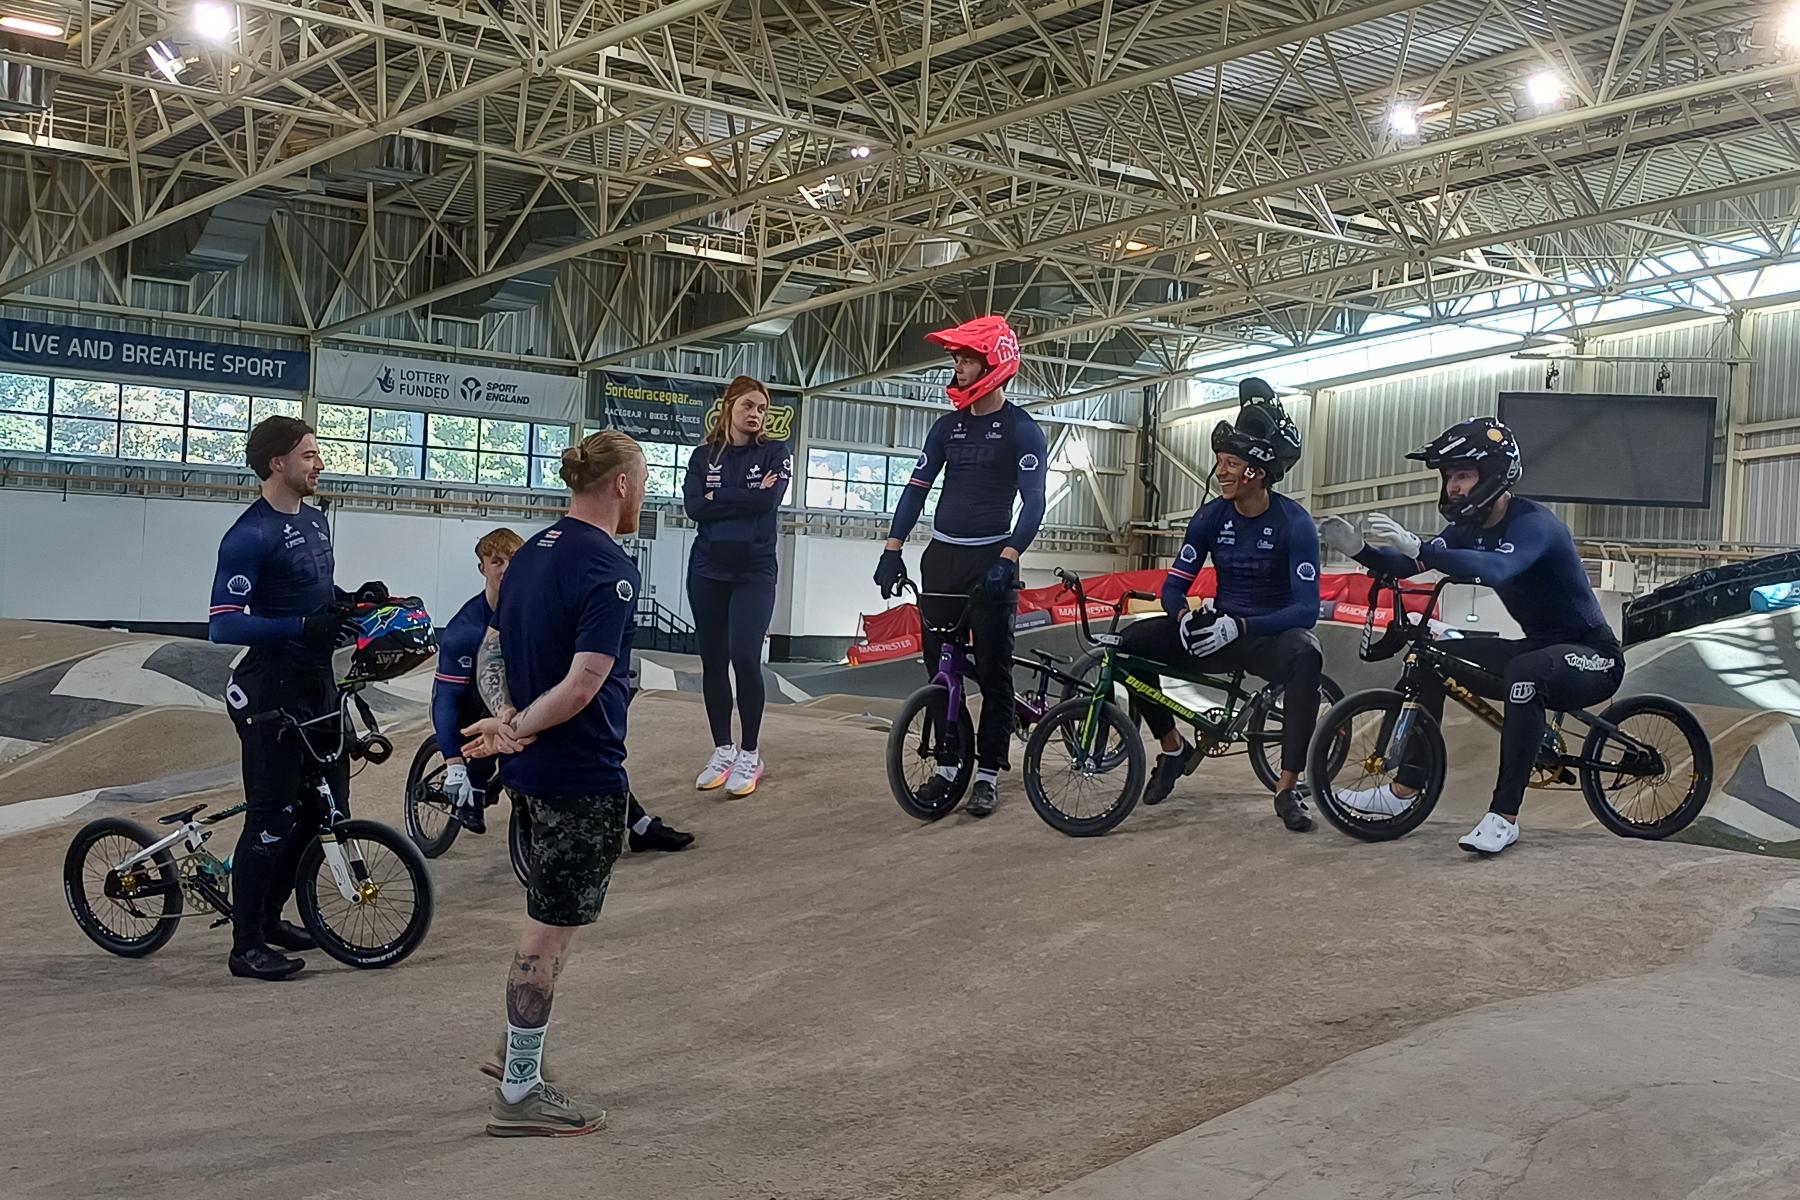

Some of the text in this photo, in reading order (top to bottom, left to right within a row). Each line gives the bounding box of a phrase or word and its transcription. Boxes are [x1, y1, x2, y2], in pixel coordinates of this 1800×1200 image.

[12, 331, 287, 378] LIVE AND BREATHE SPORT
[400, 369, 450, 385] LOTTERY
[399, 384, 450, 400] FUNDED
[486, 382, 518, 393] SPORT
[605, 382, 704, 407] Sortedracegear.com
[486, 393, 530, 405] ENGLAND
[605, 407, 642, 418] RACEGEAR
[1248, 446, 1276, 462] FLY
[858, 639, 912, 653] MANCHESTER
